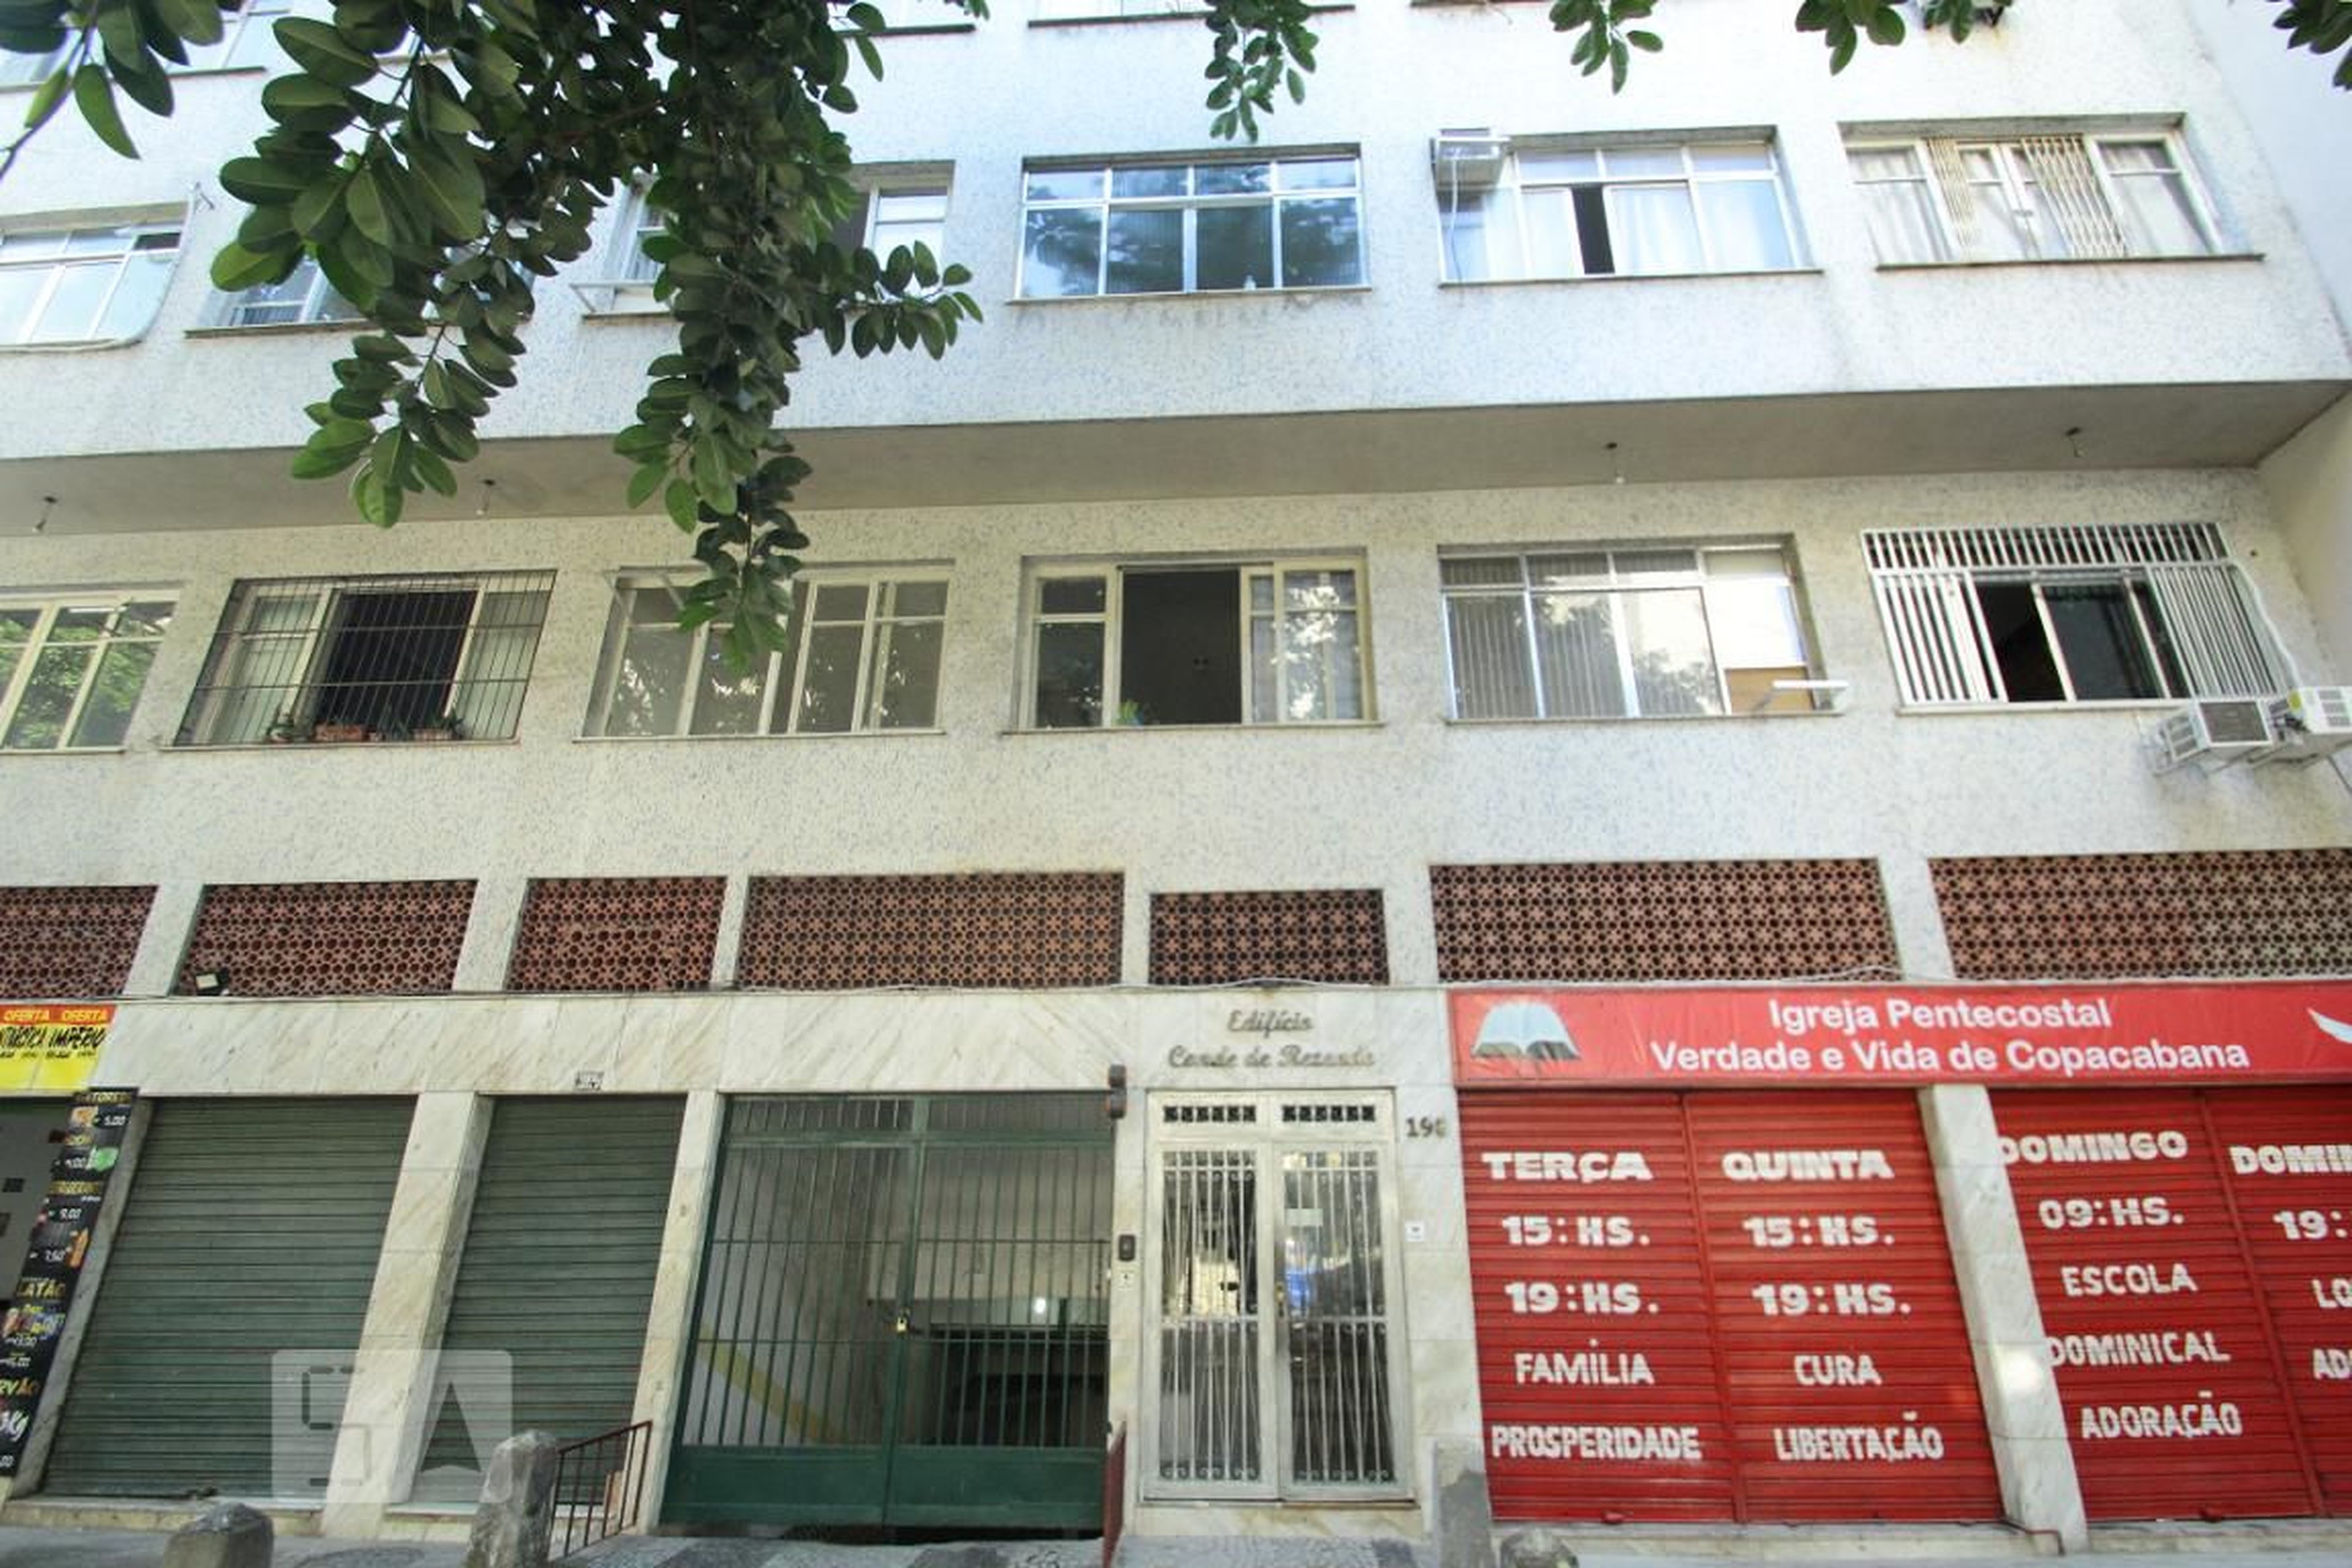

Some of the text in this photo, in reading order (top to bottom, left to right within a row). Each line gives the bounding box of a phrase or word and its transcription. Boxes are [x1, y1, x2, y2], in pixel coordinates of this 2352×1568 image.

[1766, 996, 2113, 1038] Igreja Pentecostal
[1244, 1044, 1272, 1068] de
[1649, 1038, 2250, 1078] Verdade e Vida de Copacabana
[1997, 1131, 2188, 1164] DOMINGO
[1480, 1151, 1654, 1184] TERÇA
[1721, 1149, 1895, 1182] QUINTA
[2061, 1263, 2198, 1297] ESCOLA
[1514, 1338, 1655, 1385] FAMÍLIA
[2045, 1331, 2231, 1368] DOMINICAL
[1793, 1354, 1882, 1385] CURA
[2081, 1390, 2242, 1439] ADORAÇÃO
[1491, 1425, 1702, 1460] PROSPERIDADE
[1773, 1411, 1944, 1461] LIBERTAÇÃO
